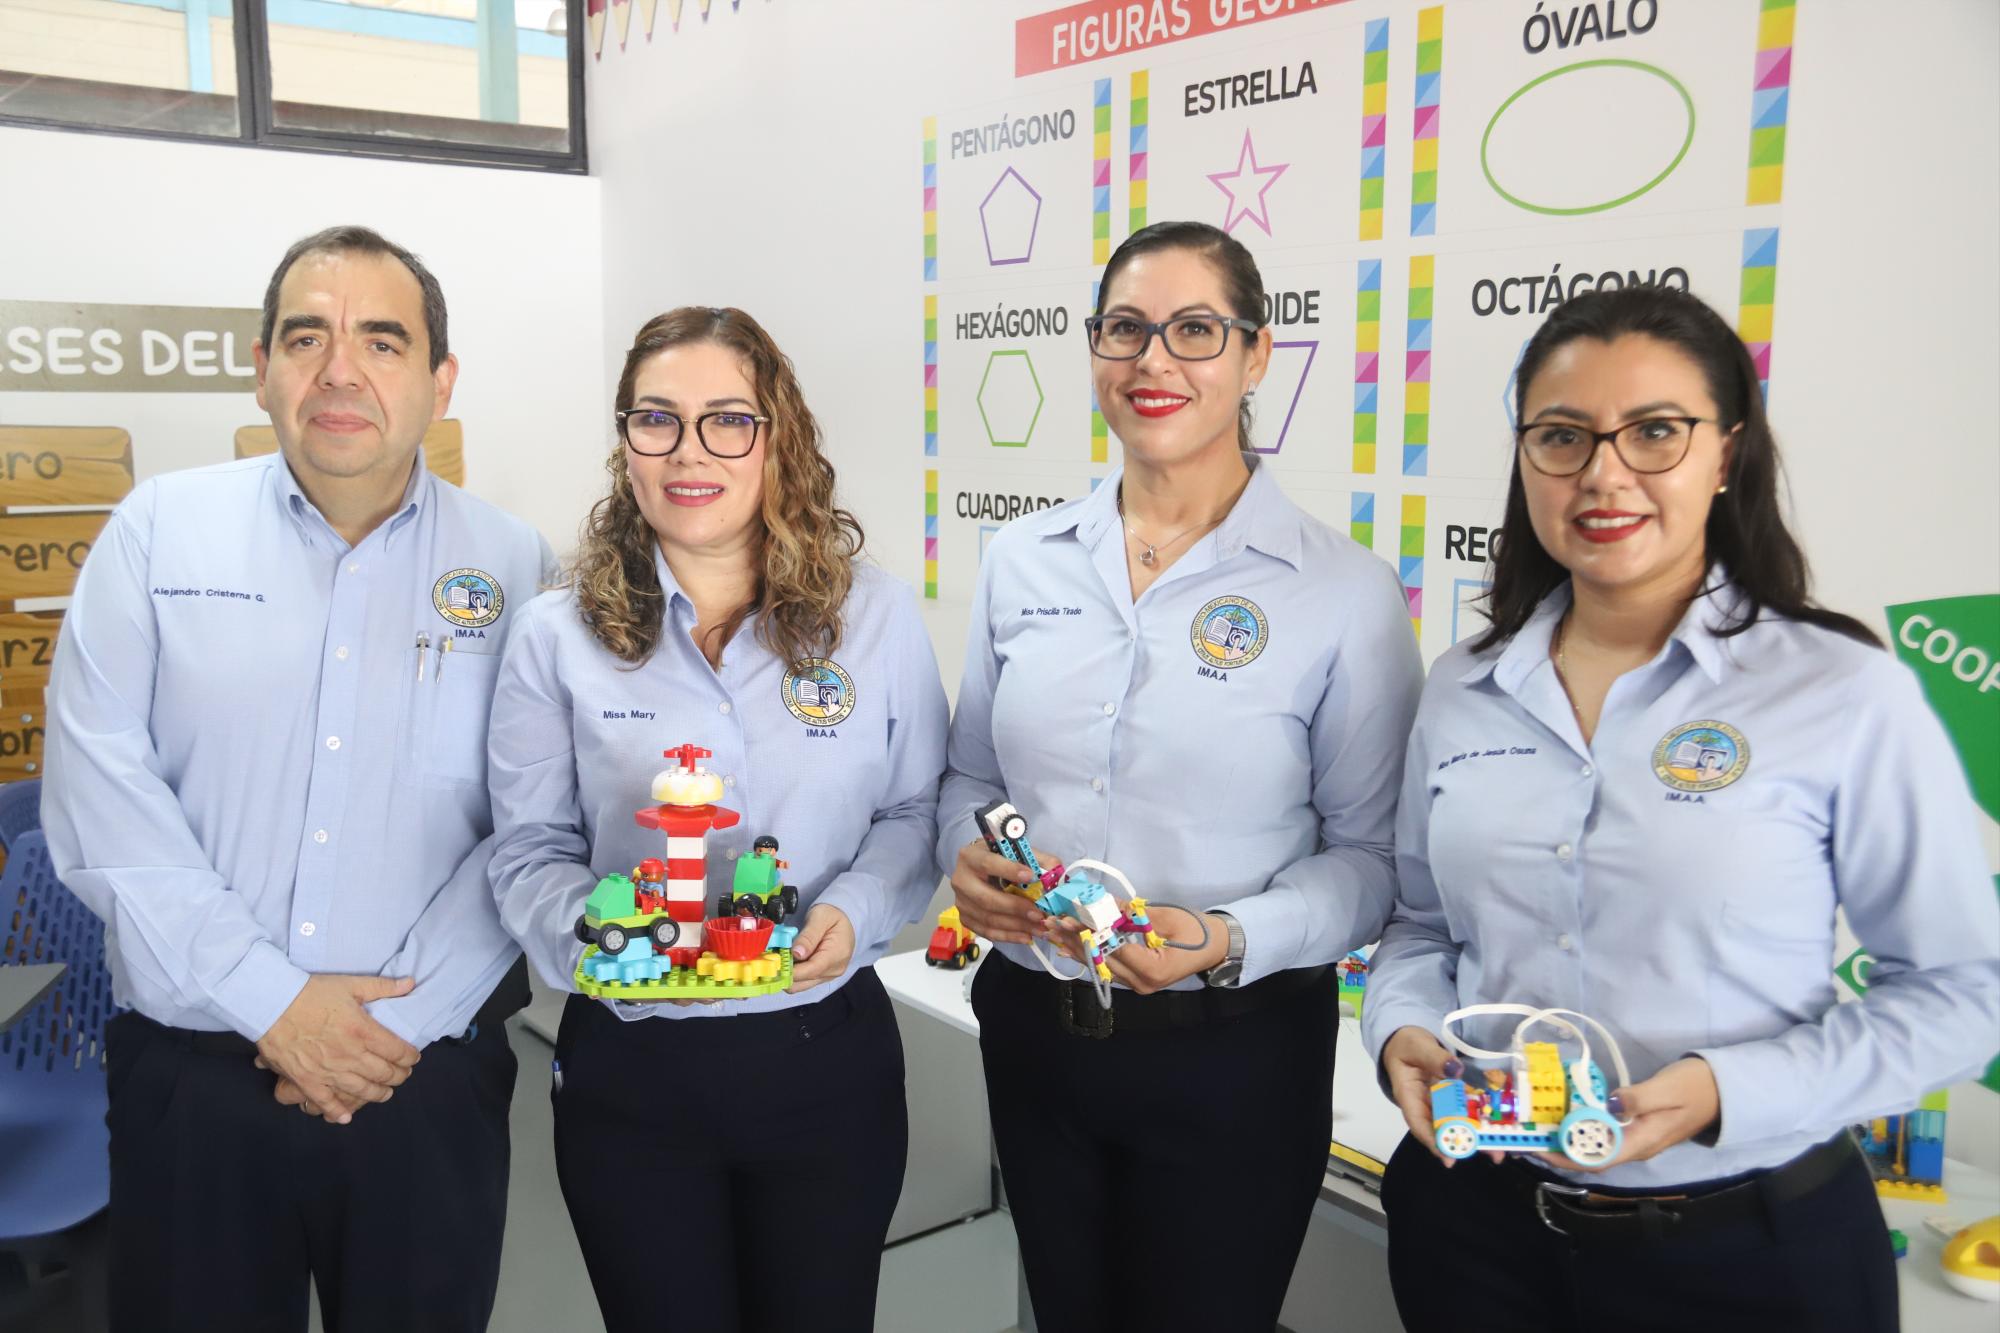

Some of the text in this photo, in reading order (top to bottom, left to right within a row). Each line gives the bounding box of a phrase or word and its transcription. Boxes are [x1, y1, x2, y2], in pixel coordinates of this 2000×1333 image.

[1052, 0, 1191, 65] FIGURAS
[1523, 0, 1658, 54] ÓVALO
[1184, 61, 1317, 117] ESTRELLA
[951, 108, 1075, 160] PENTÁGONO
[956, 302, 1068, 340] HEXÁGONO
[0, 326, 256, 377] SES DEL
[153, 588, 201, 597] Alejandro
[206, 589, 251, 600] Cristerna
[1197, 666, 1227, 682] IMAA
[603, 710, 656, 720] Miss Mary
[806, 729, 837, 738] IMAA
